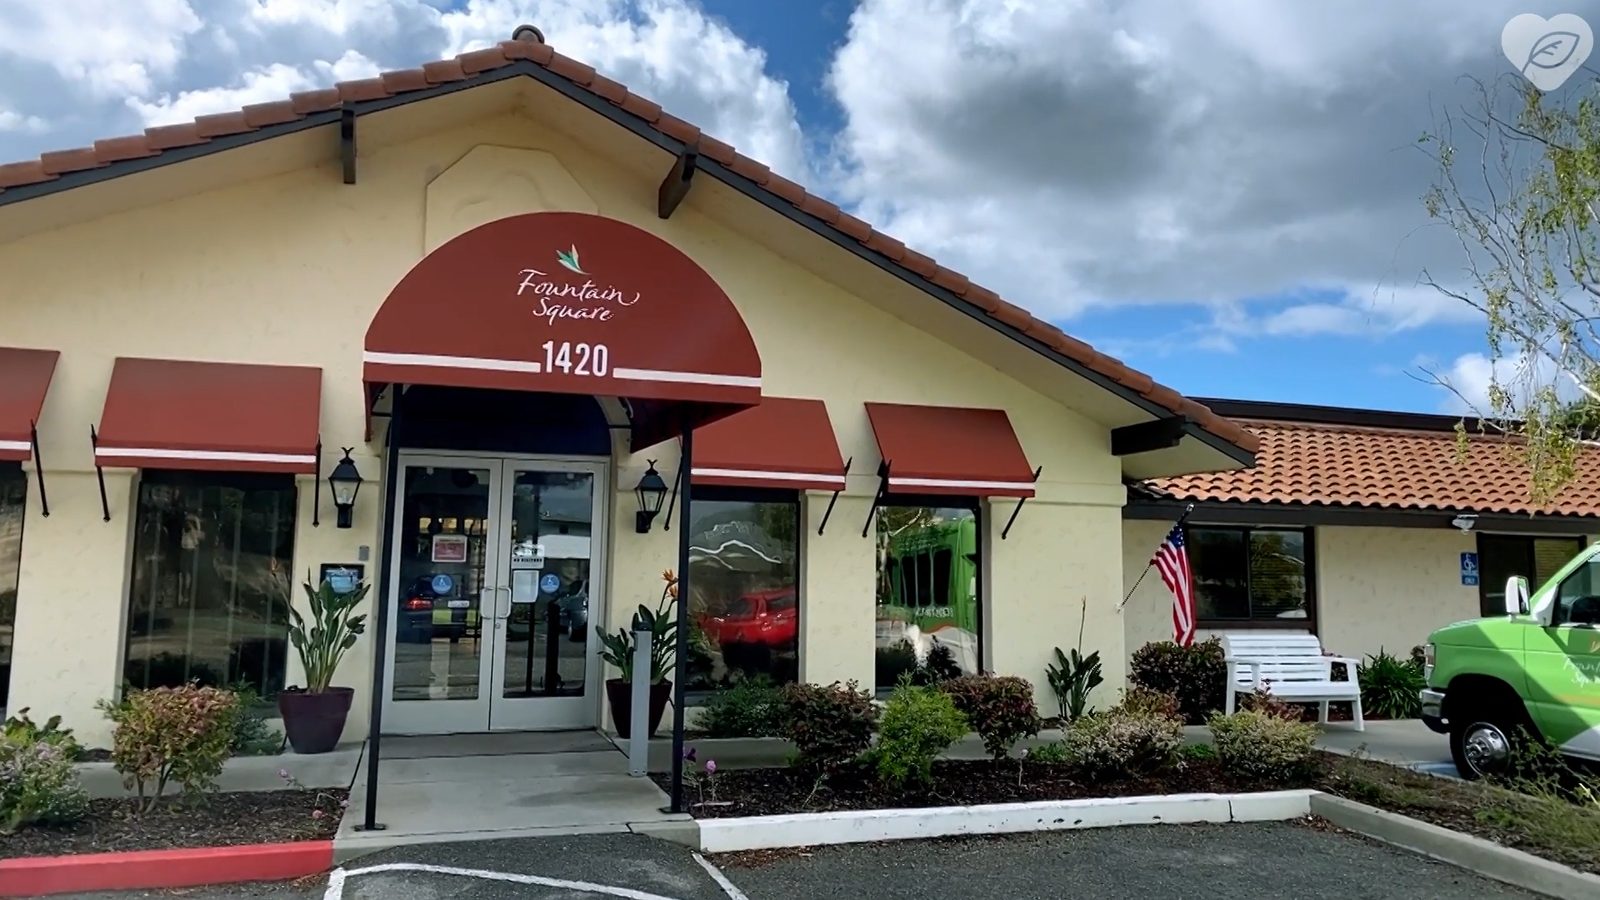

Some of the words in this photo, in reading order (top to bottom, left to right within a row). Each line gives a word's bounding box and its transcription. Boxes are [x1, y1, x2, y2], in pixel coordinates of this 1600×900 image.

[517, 269, 640, 305] Fountain
[533, 297, 614, 326] Square
[542, 340, 608, 377] 1420
